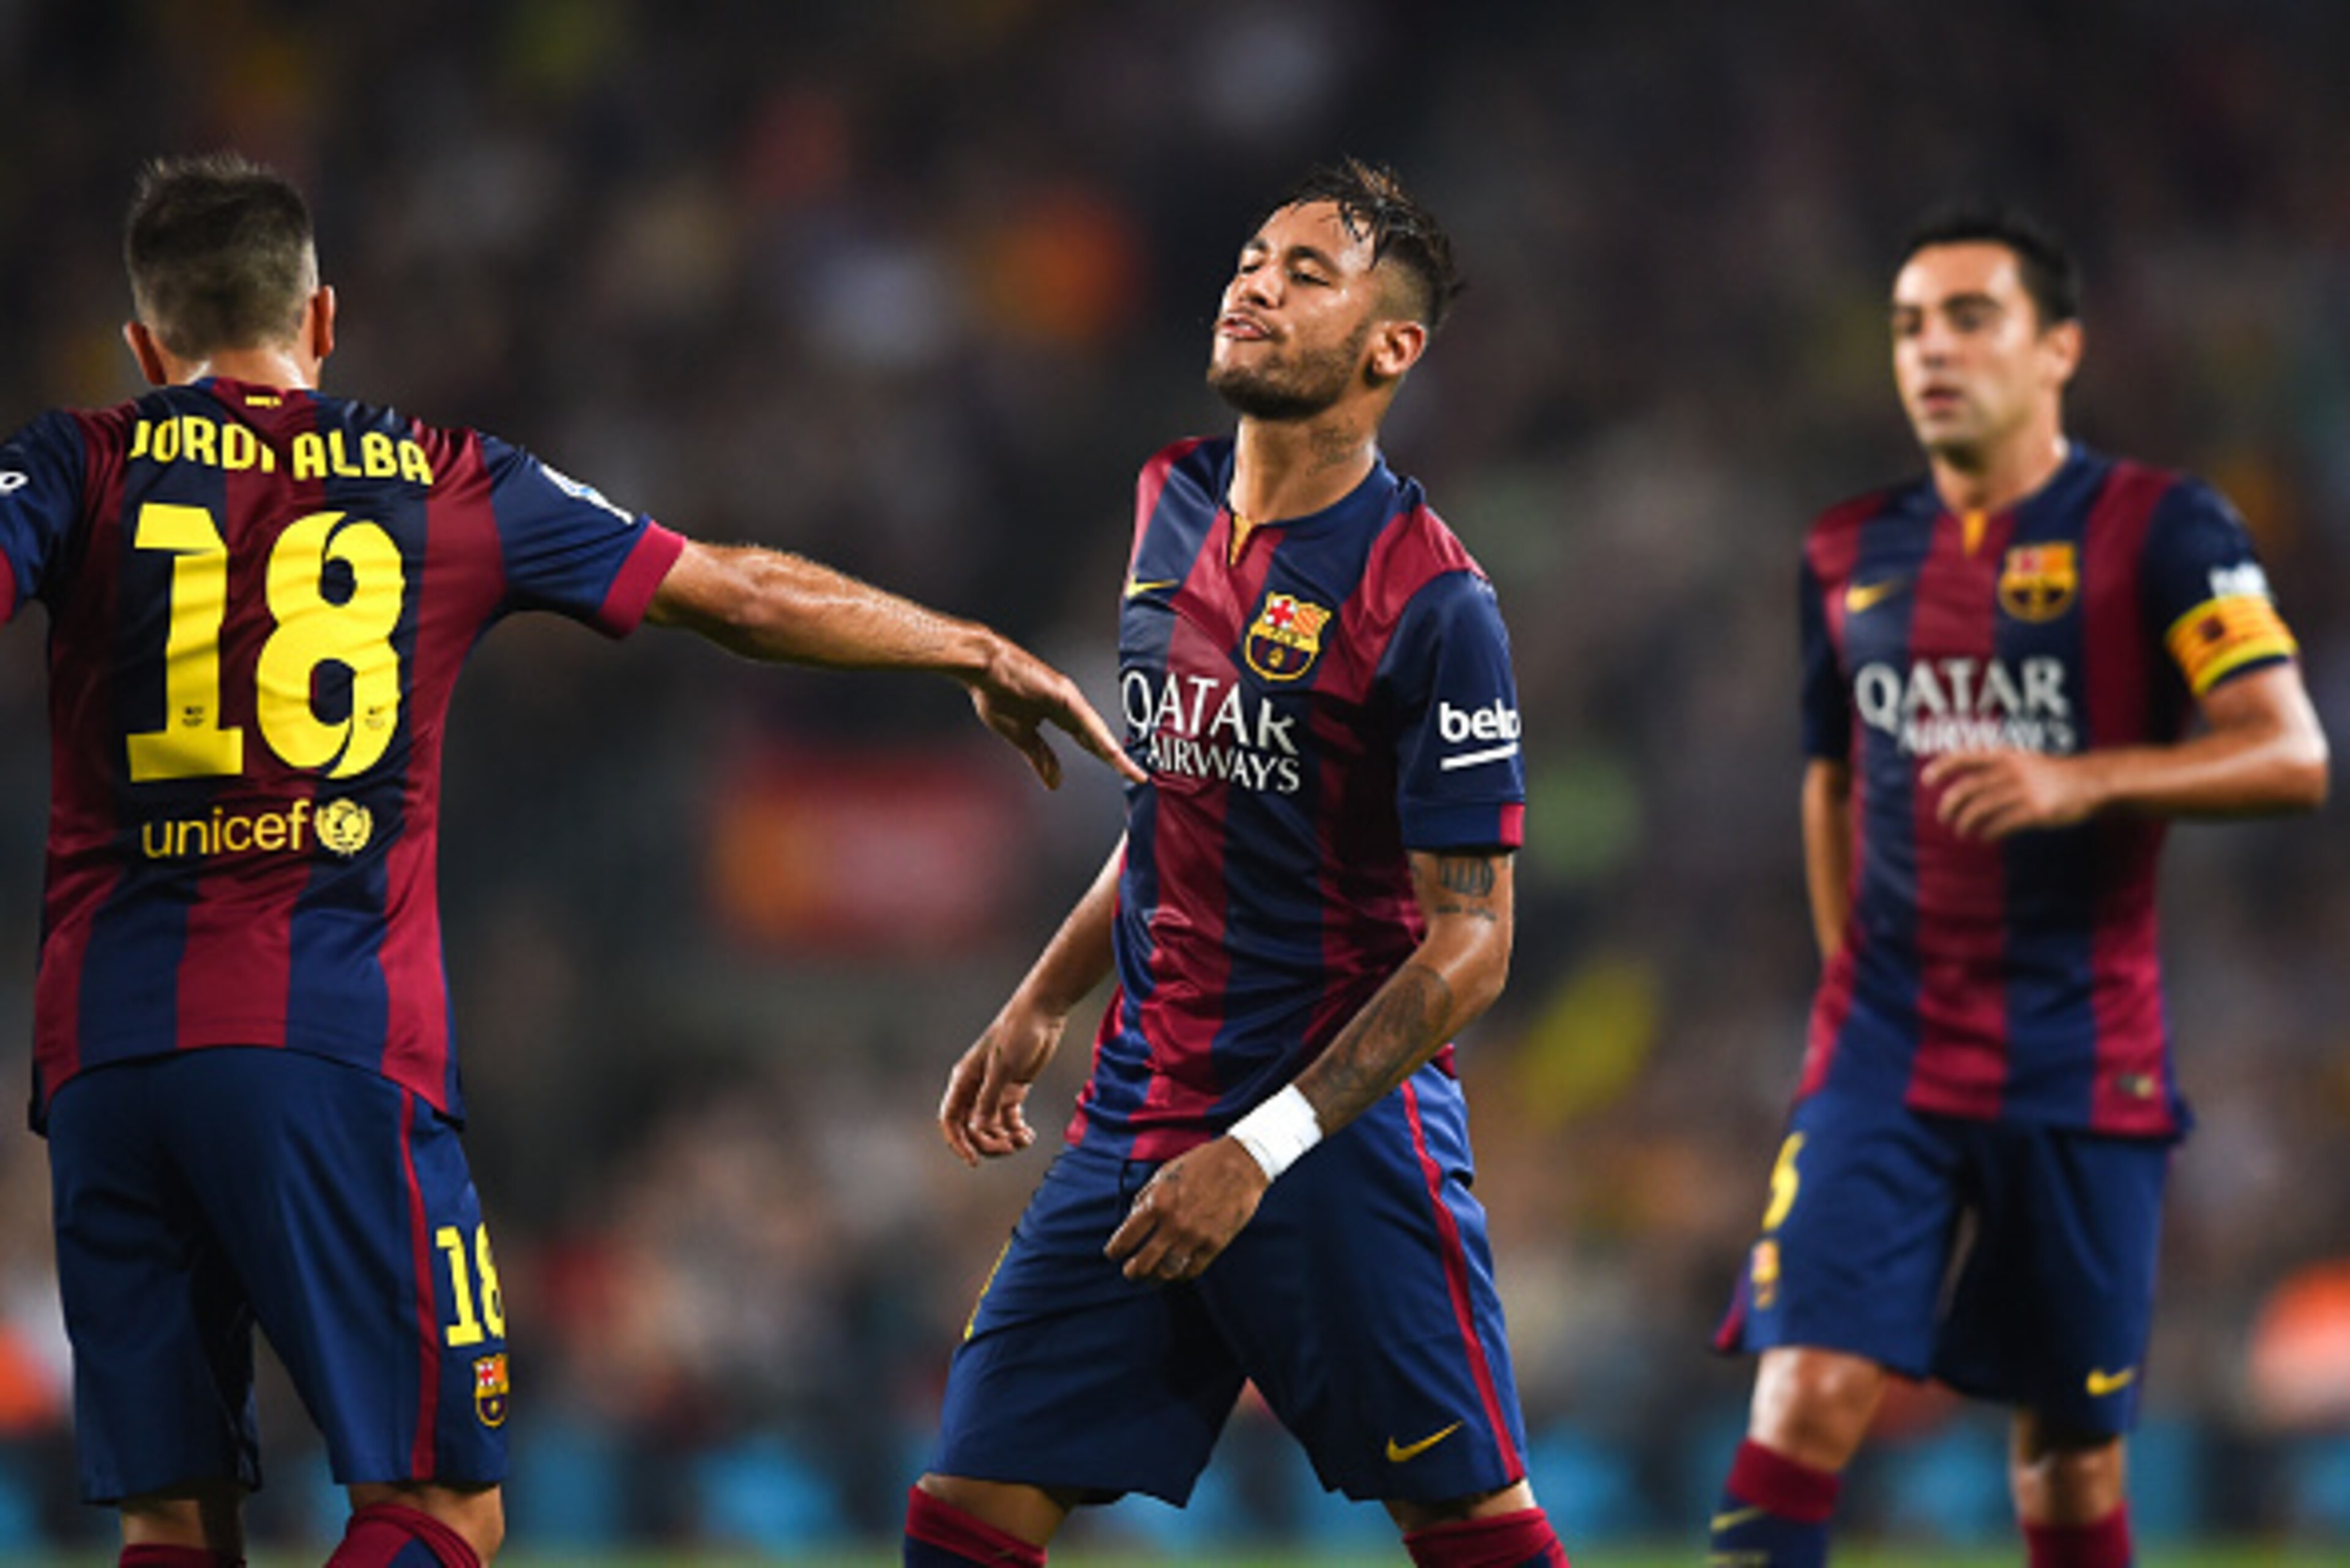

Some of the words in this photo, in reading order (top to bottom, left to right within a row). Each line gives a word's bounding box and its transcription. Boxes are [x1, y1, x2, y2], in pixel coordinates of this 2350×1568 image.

[129, 415, 275, 473] JORDI
[293, 430, 433, 485] ALBA
[127, 502, 405, 783] 18
[1122, 670, 1299, 755] QATAR
[1856, 657, 2069, 737] QATAR
[1147, 732, 1300, 793] AIRWAYS
[142, 797, 310, 858] unicef
